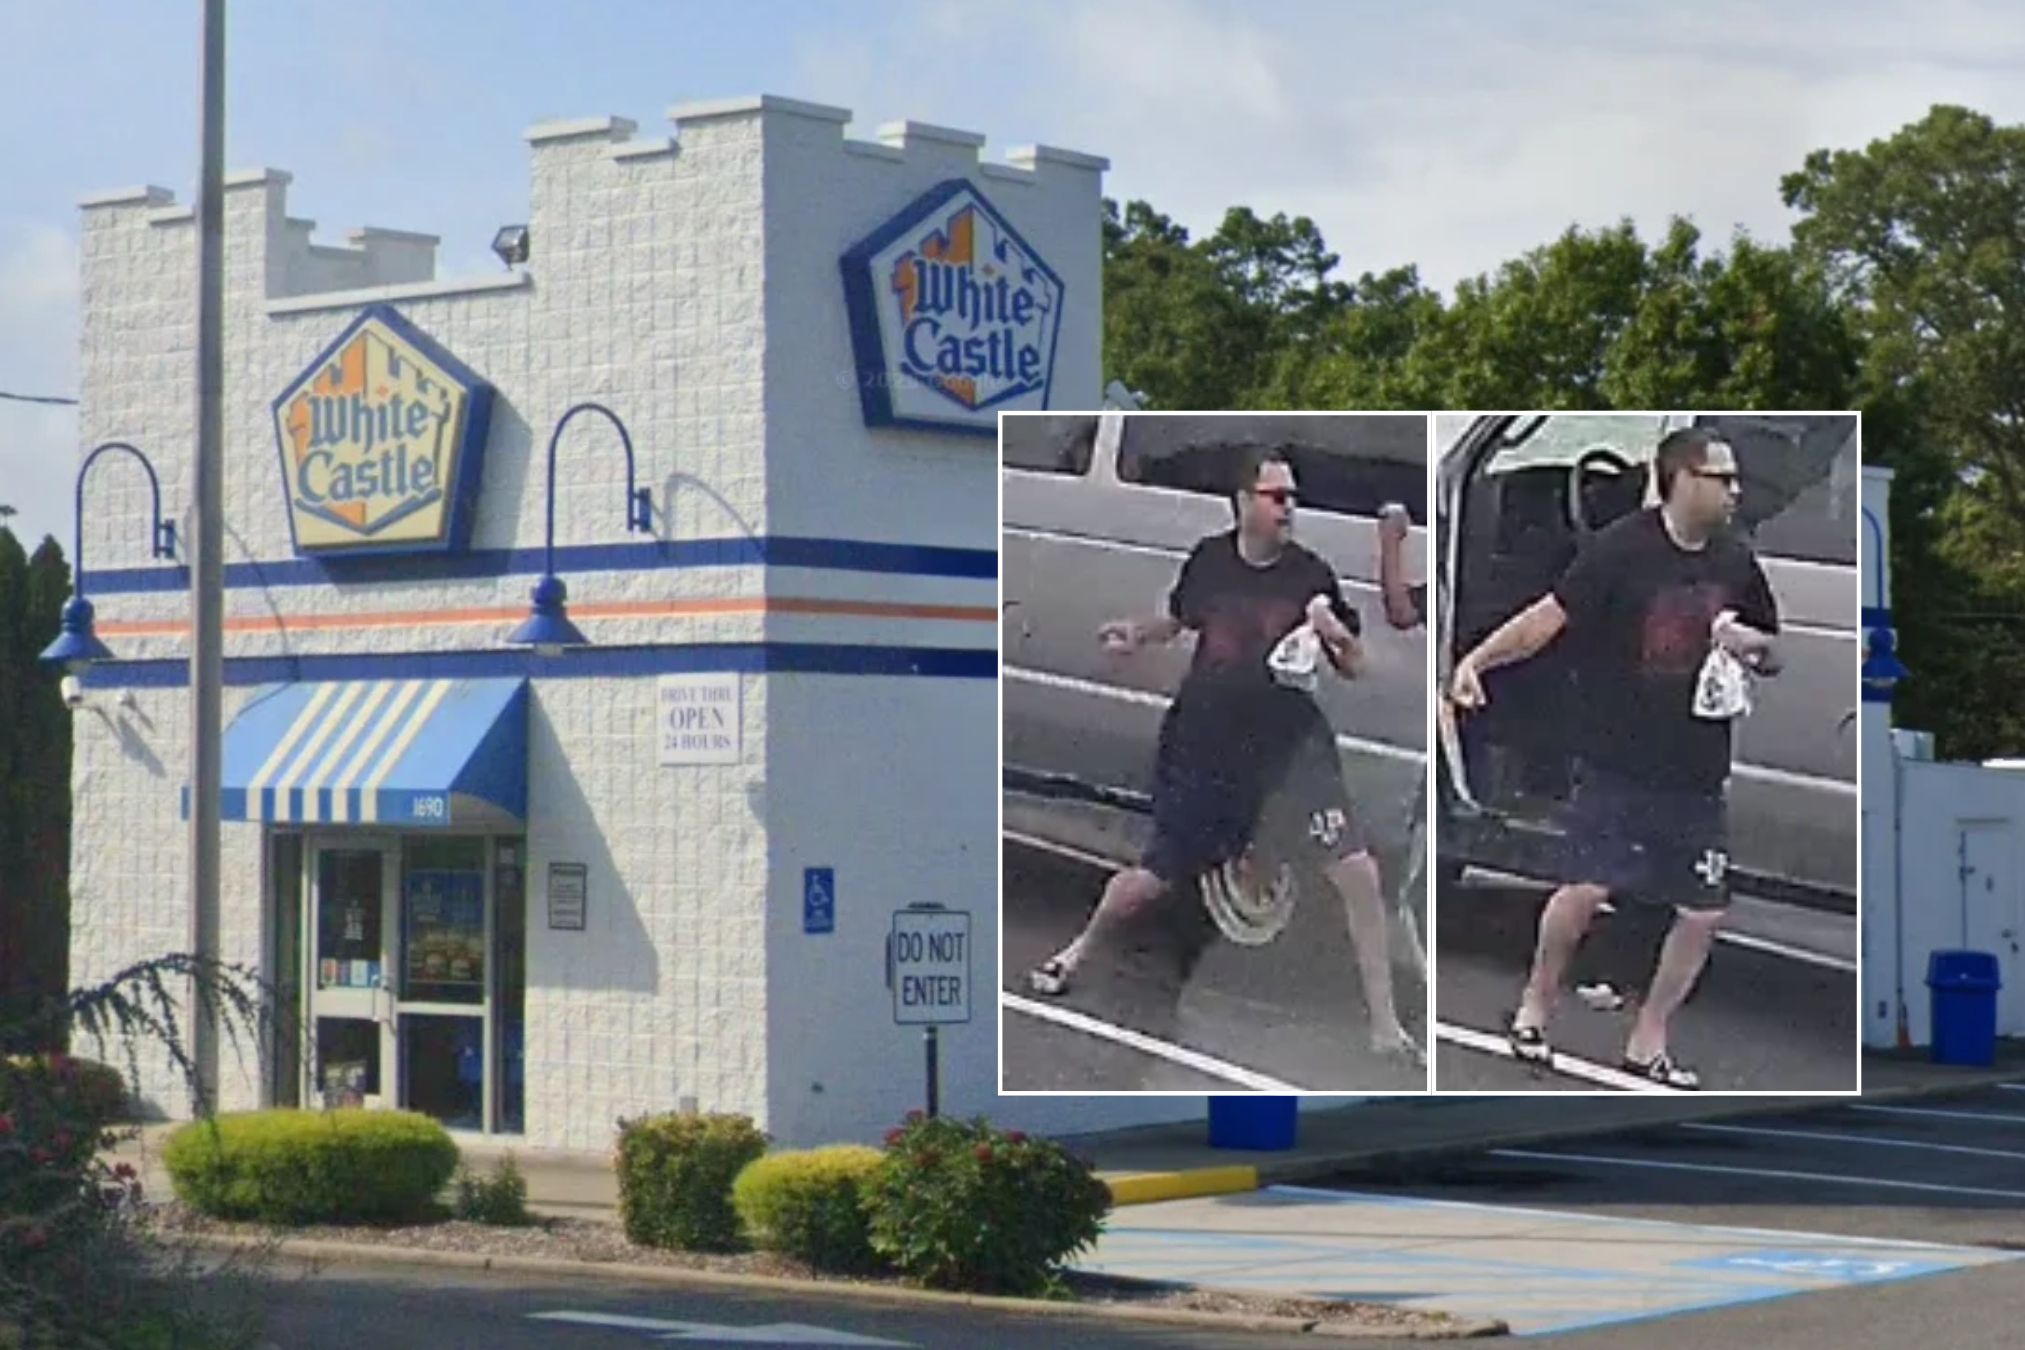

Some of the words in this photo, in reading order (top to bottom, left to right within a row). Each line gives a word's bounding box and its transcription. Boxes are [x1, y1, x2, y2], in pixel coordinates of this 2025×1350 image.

[912, 258, 1036, 331] White
[903, 316, 1041, 381] Castle
[308, 392, 429, 454] White
[299, 443, 434, 503] Castle
[669, 705, 726, 730] OPEN
[413, 796, 444, 817] 1690
[897, 931, 924, 963] DO
[928, 931, 965, 963] NOT
[902, 975, 962, 1006] ENTER
